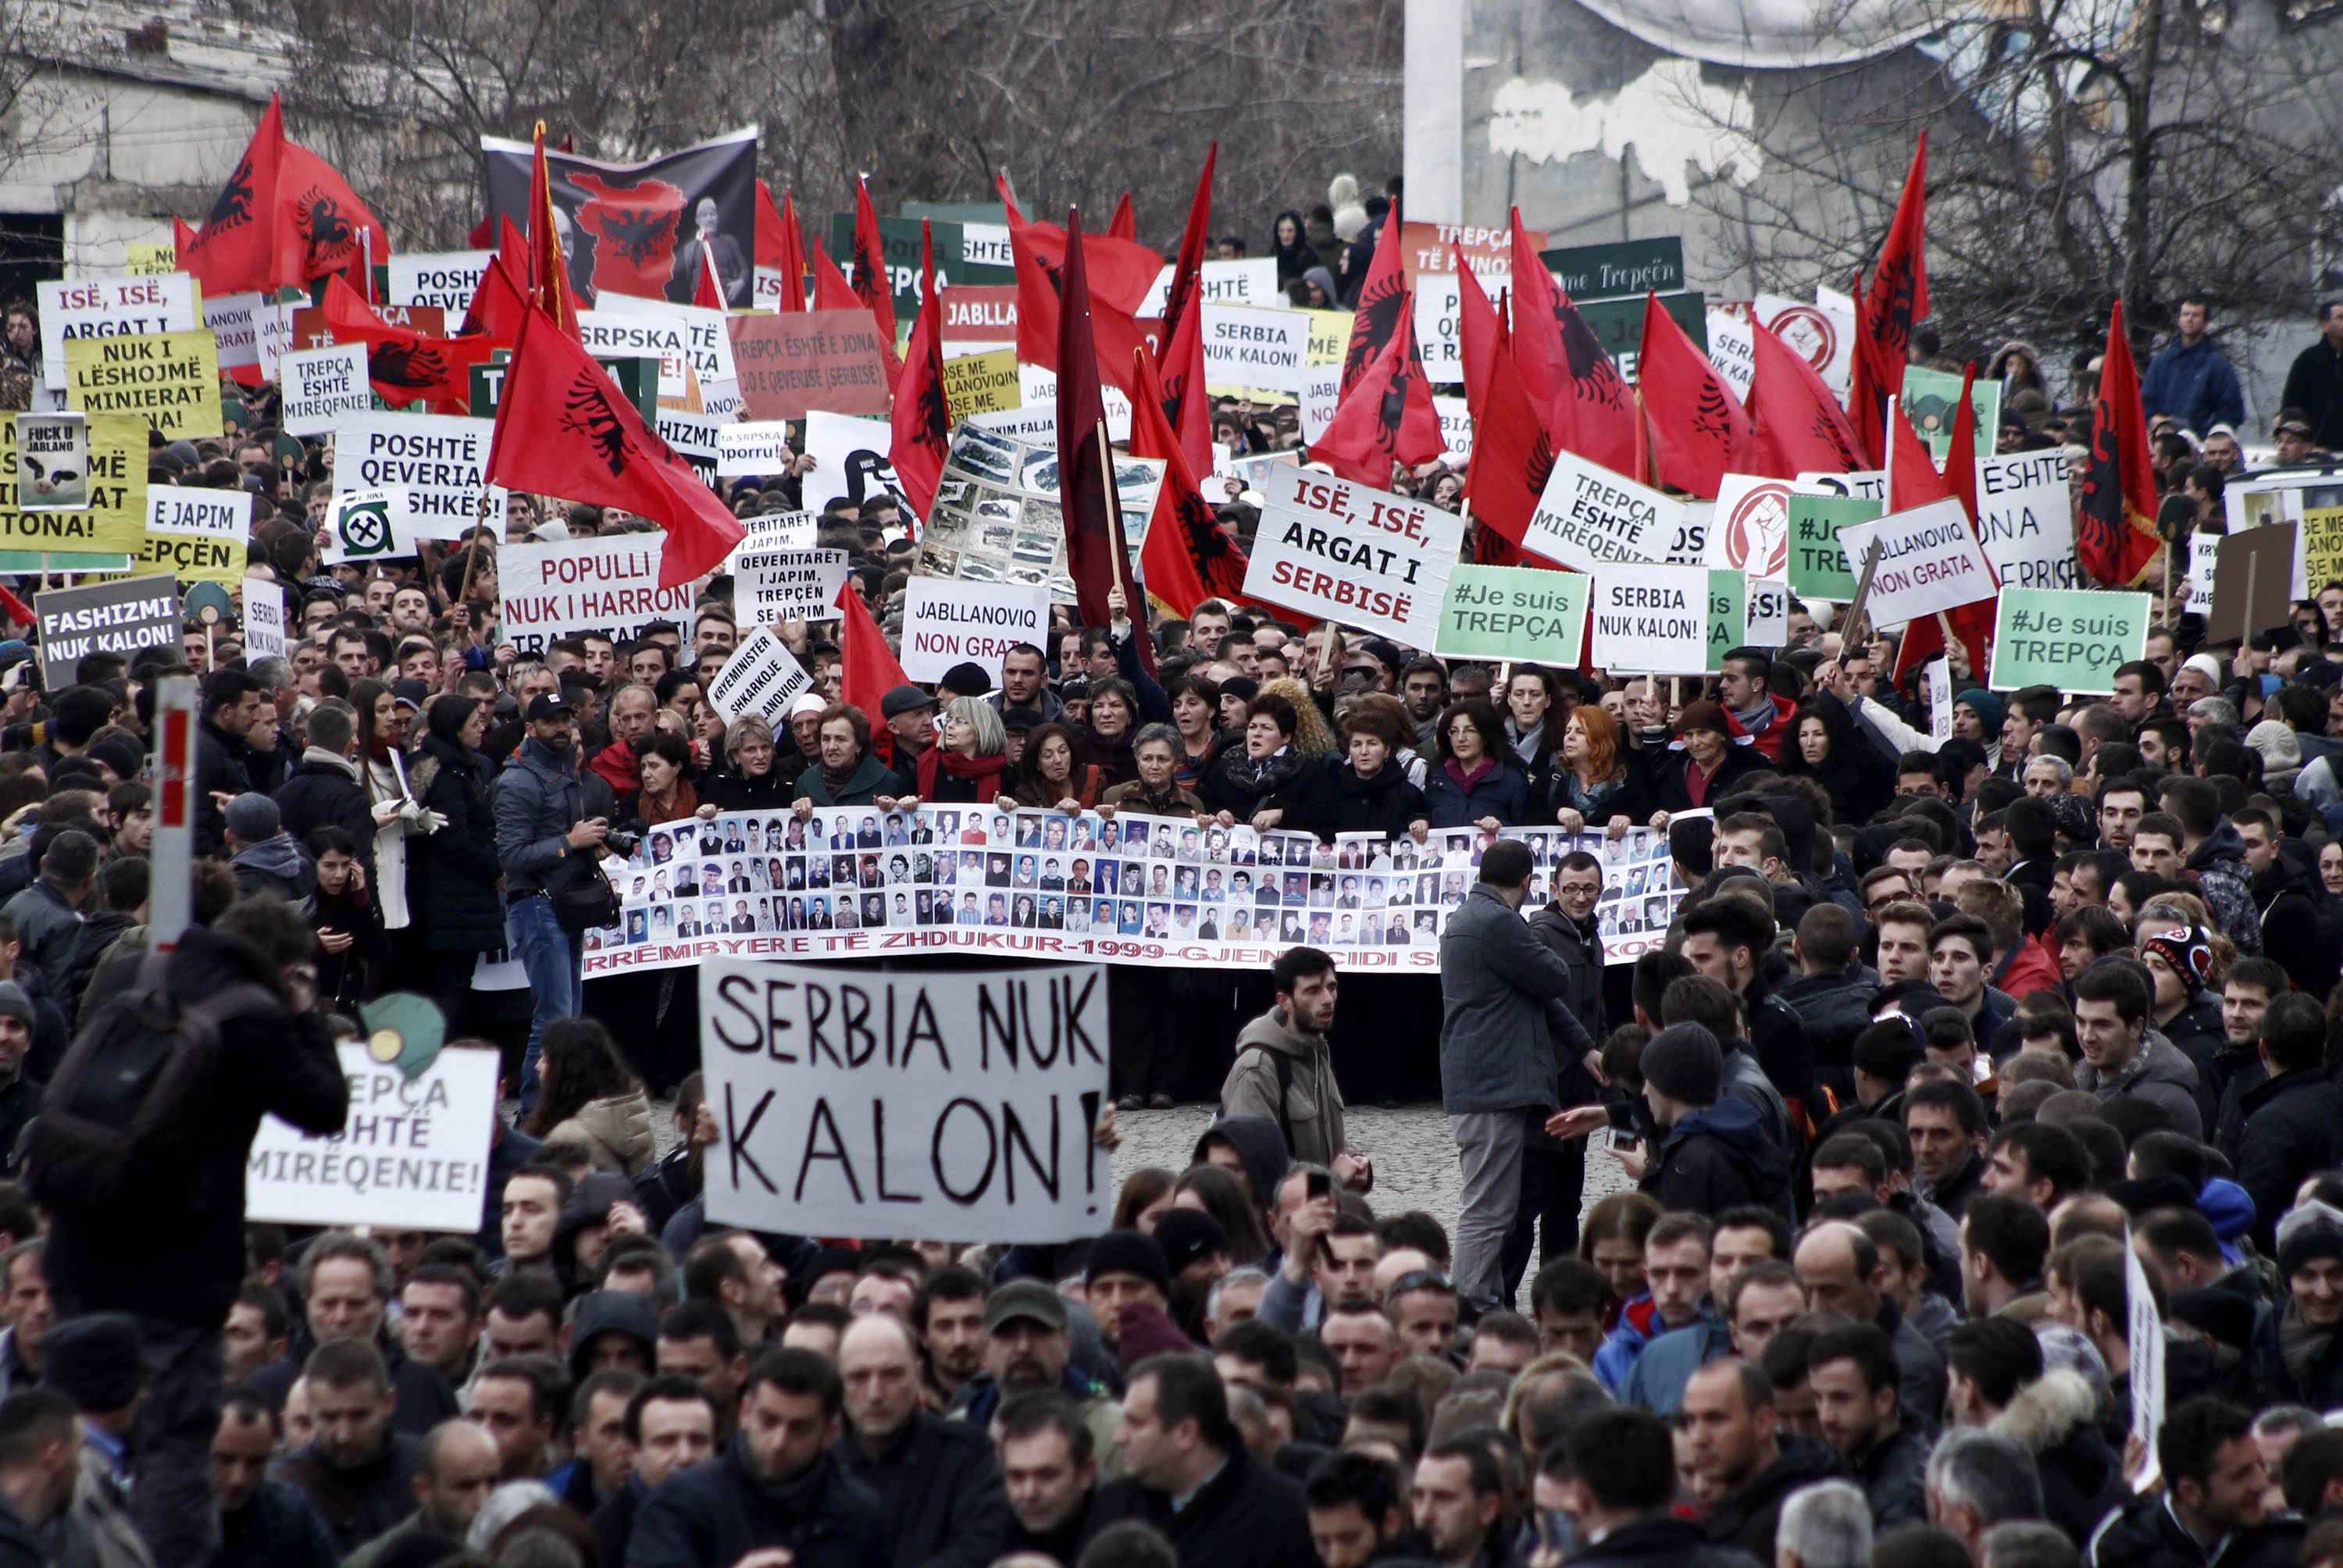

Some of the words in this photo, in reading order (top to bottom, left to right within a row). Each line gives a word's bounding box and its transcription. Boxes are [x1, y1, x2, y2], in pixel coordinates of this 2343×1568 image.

[963, 238, 1011, 260] SHTË
[417, 270, 486, 290] POSH
[756, 276, 781, 295] IS
[58, 283, 109, 312] ISË,
[118, 279, 169, 308] ISË,
[947, 301, 1018, 326] JABLLA
[1215, 323, 1287, 344] SERBIA
[102, 344, 154, 363] NUK
[162, 340, 171, 357] I
[1240, 349, 1297, 368] KALON!
[78, 356, 201, 390] LËSHOJMË
[296, 358, 354, 379] TREPÇA
[947, 371, 1020, 395] LANOVIQIN
[84, 386, 205, 412] MINIERAT
[303, 376, 350, 397] ËSHTË
[28, 426, 61, 441] FUCK
[62, 426, 73, 439] U
[370, 433, 476, 461] POSHTË
[656, 419, 718, 448] HIZMI
[361, 460, 481, 488] QEVERIA
[1293, 479, 1356, 525] ISË,
[1368, 501, 1430, 548] ISË,
[1574, 472, 1657, 527] TREPÇA
[0, 513, 94, 538] TONA!
[155, 501, 166, 525] E
[172, 501, 234, 531] JAPIM
[742, 514, 811, 535] VERITARËT
[1570, 494, 1645, 545] ËSHTË
[140, 537, 230, 571] EPÇËN
[741, 550, 842, 570] QEVERITARËT
[1282, 522, 1397, 575] ARGAT
[1403, 558, 1421, 585] I
[541, 551, 651, 586] POPULLI
[759, 573, 764, 585] I
[1913, 553, 1975, 586] GRATA
[505, 594, 561, 625] NUK
[567, 594, 574, 619] I
[581, 585, 691, 619] HARRON
[757, 584, 824, 605] TREPÇËN
[1271, 560, 1412, 624] SERBISË
[1454, 583, 1504, 606] #Je
[1512, 590, 1569, 613] suis
[1611, 586, 1686, 610] SERBIA
[44, 597, 174, 636] FASHIZMI
[757, 608, 774, 623] SE
[915, 600, 1036, 629] JABLLANOVIQ
[1452, 610, 1565, 643] TREPÇA
[1599, 615, 1634, 637] NUK
[1637, 616, 1698, 640] KALON!
[2011, 608, 2063, 634] #Je
[2070, 613, 2130, 637] suis
[47, 638, 91, 662] NUK
[98, 625, 175, 653] KALON!
[915, 632, 960, 655] NON
[2010, 640, 2126, 671] TREPÇA
[713, 634, 772, 704] KRYEMINISTËR
[730, 659, 782, 716] SHKARKOJE
[711, 974, 951, 1072] SERBIA
[978, 970, 1104, 1073] NUK
[348, 1074, 449, 1118] EPÇA
[725, 1082, 1102, 1217] KALON!
[247, 1144, 480, 1196] MIRËQENIE!
